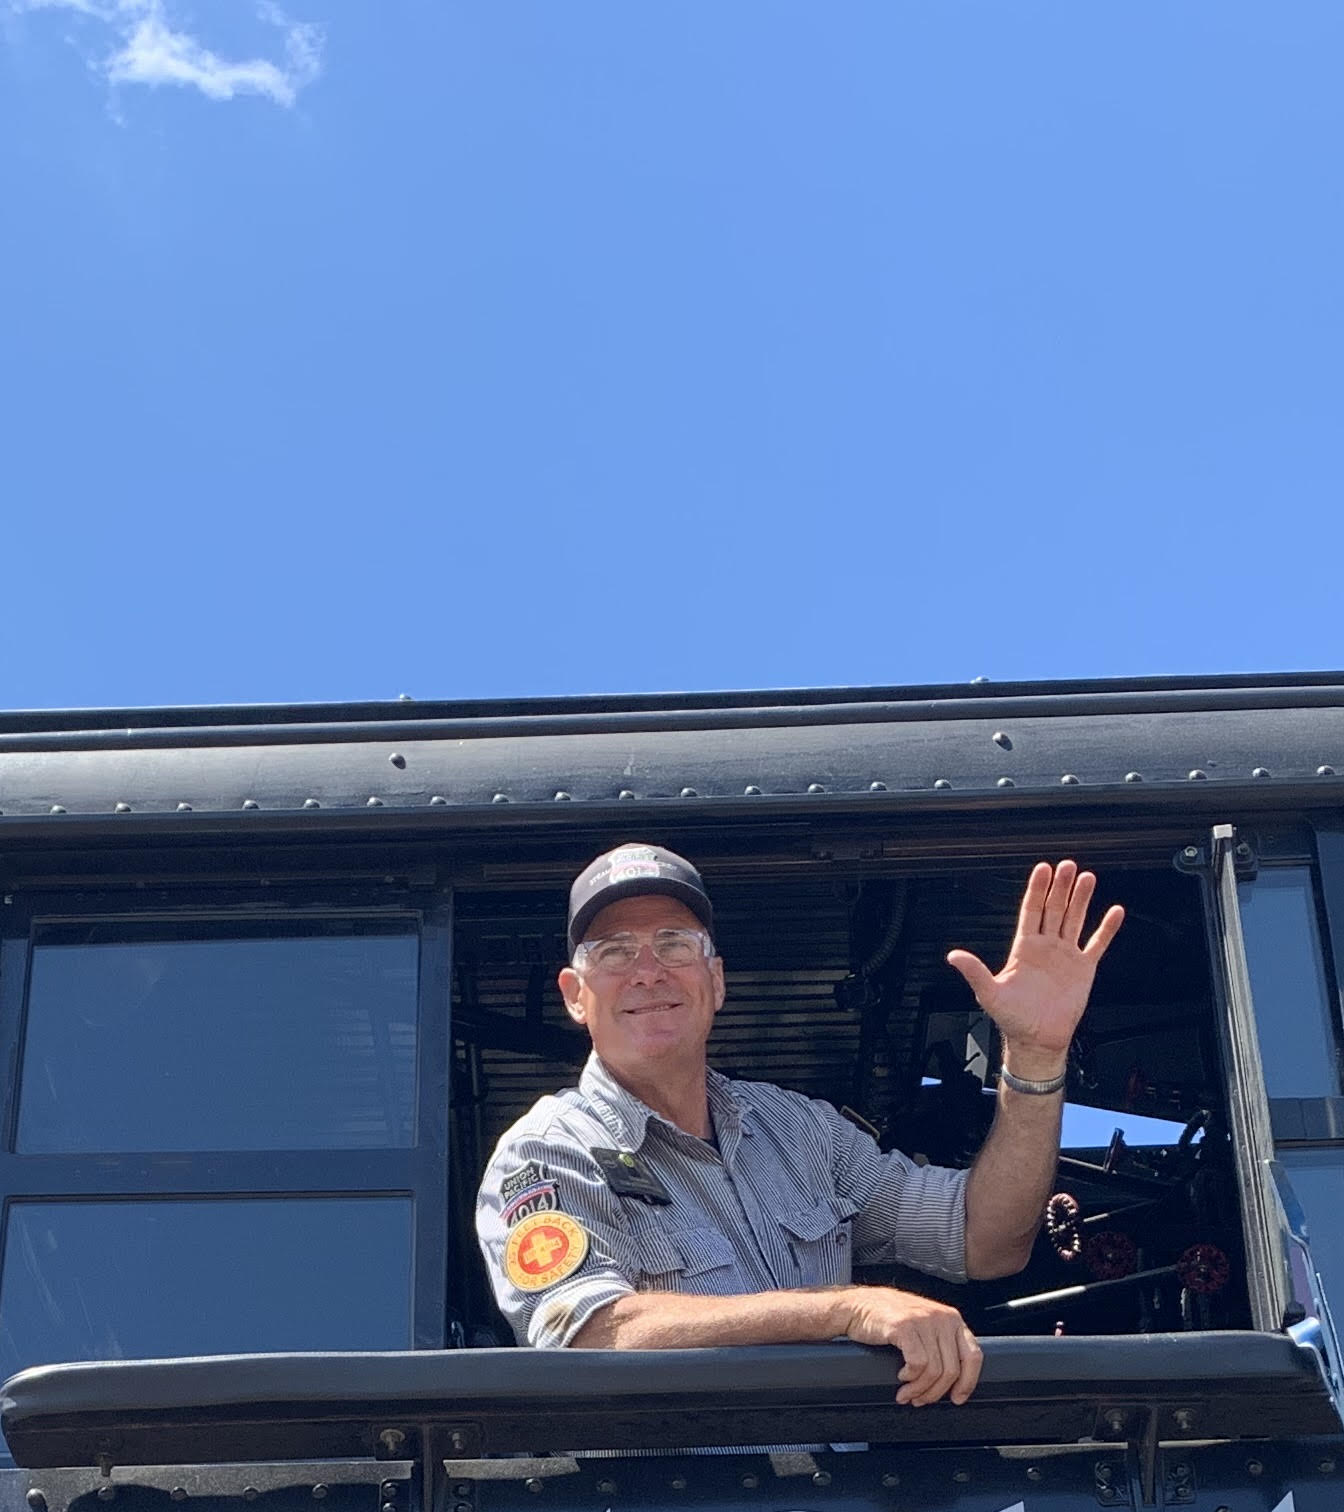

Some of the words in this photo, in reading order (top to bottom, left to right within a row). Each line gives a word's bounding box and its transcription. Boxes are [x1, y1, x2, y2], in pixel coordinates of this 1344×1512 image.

[504, 1167, 535, 1191] UNION
[504, 1174, 539, 1199] PACIFIC
[543, 1216, 578, 1236] BACK
[541, 1244, 581, 1284] SAFETY
